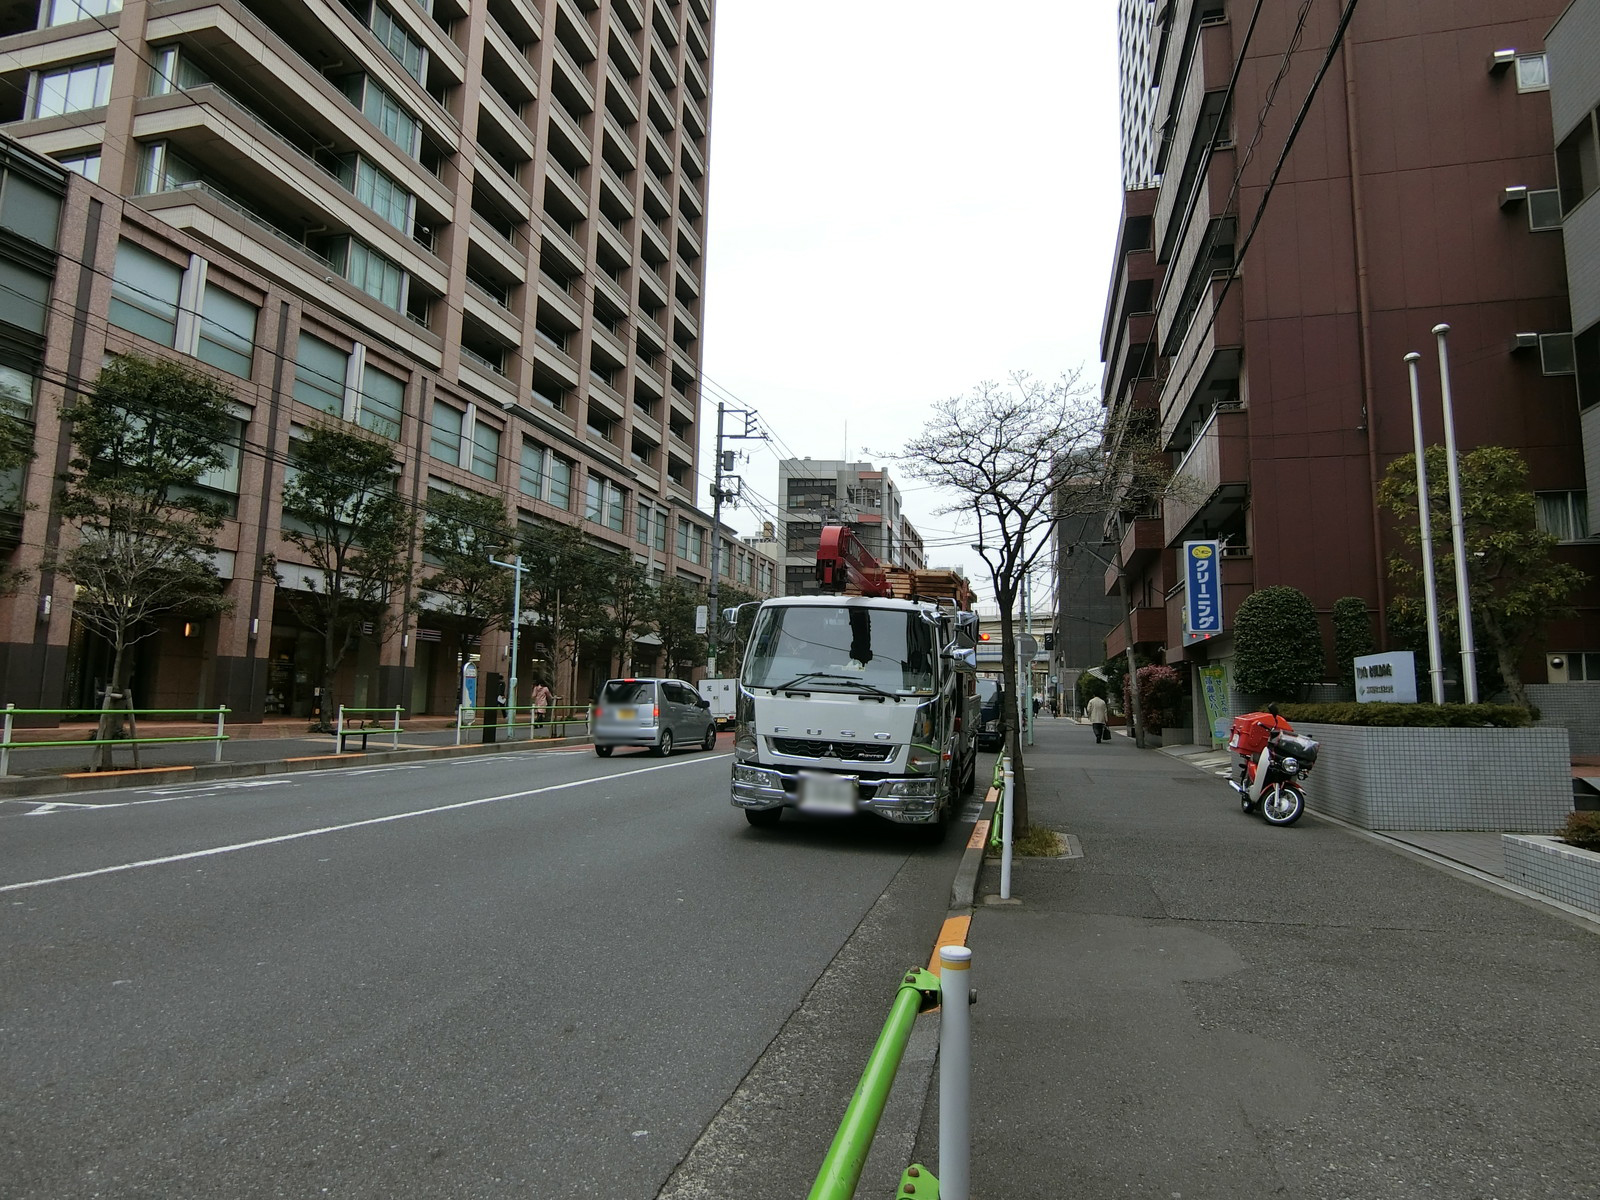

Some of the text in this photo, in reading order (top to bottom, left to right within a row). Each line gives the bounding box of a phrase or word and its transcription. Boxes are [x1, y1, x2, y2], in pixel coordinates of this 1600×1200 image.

[1196, 560, 1214, 629] クリーニング
[774, 725, 892, 740] FUSO
